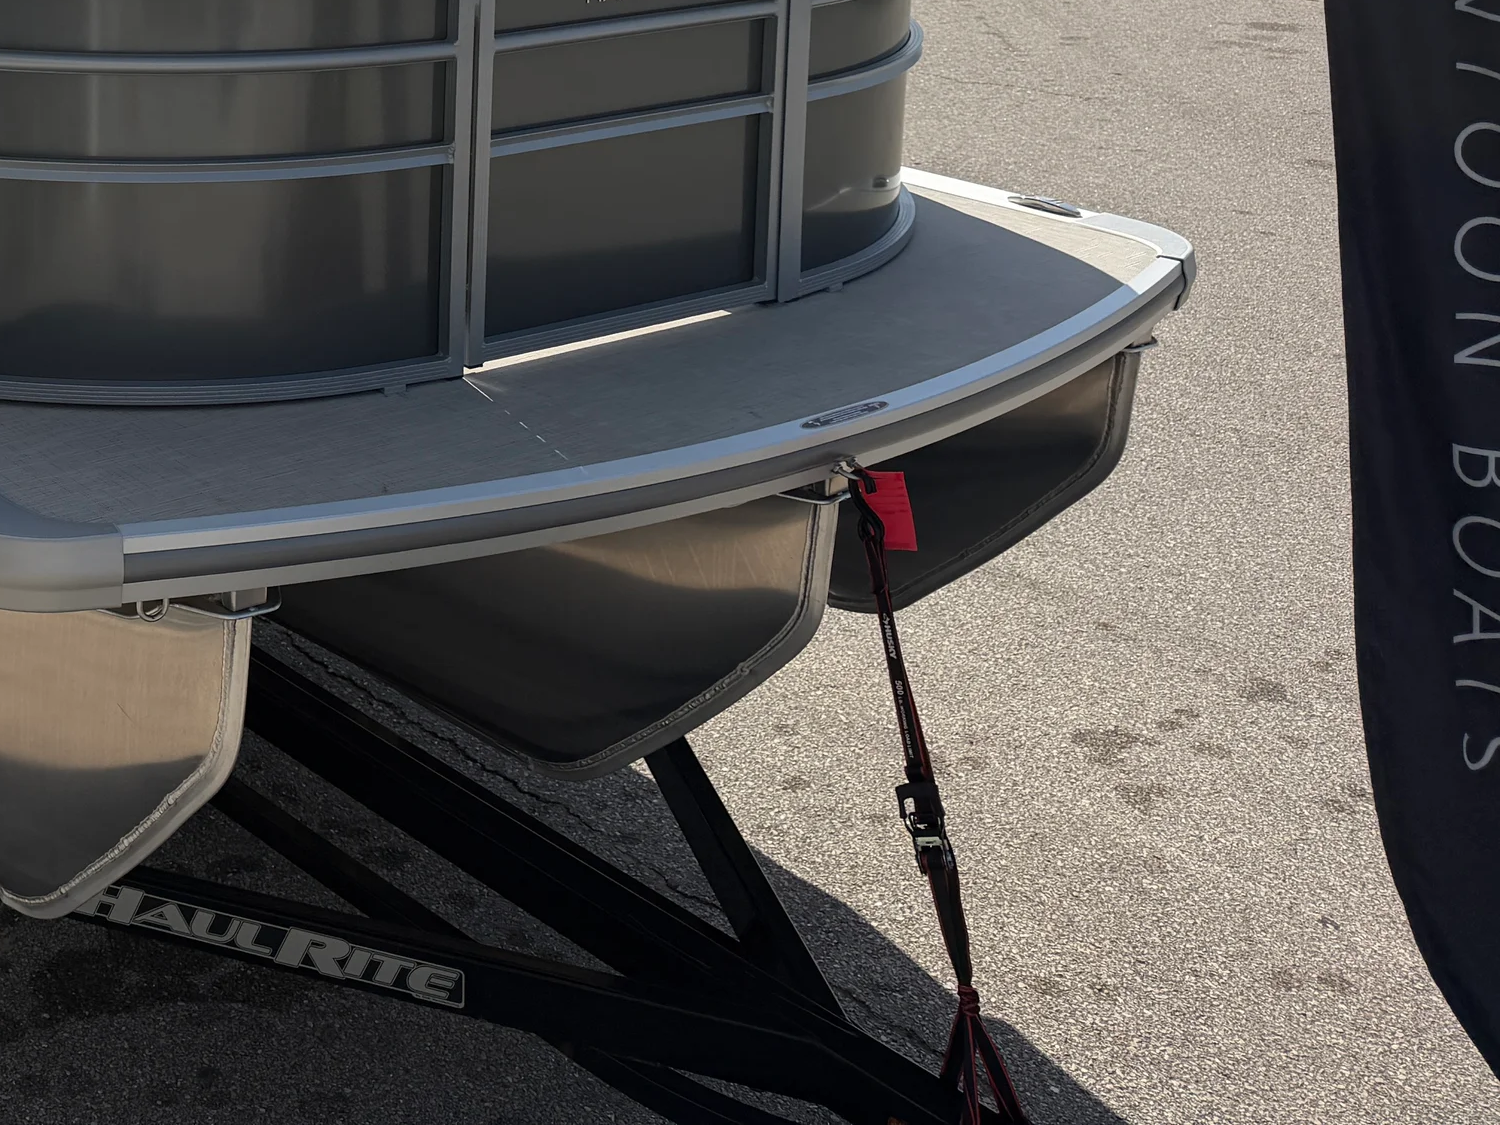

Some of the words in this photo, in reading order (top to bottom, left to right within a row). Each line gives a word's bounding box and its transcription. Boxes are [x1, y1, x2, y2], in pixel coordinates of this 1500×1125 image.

[884, 625, 897, 660] HUSKY
[894, 680, 904, 695] 500
[904, 730, 912, 745] LOAD
[907, 745, 915, 759] LIMIT
